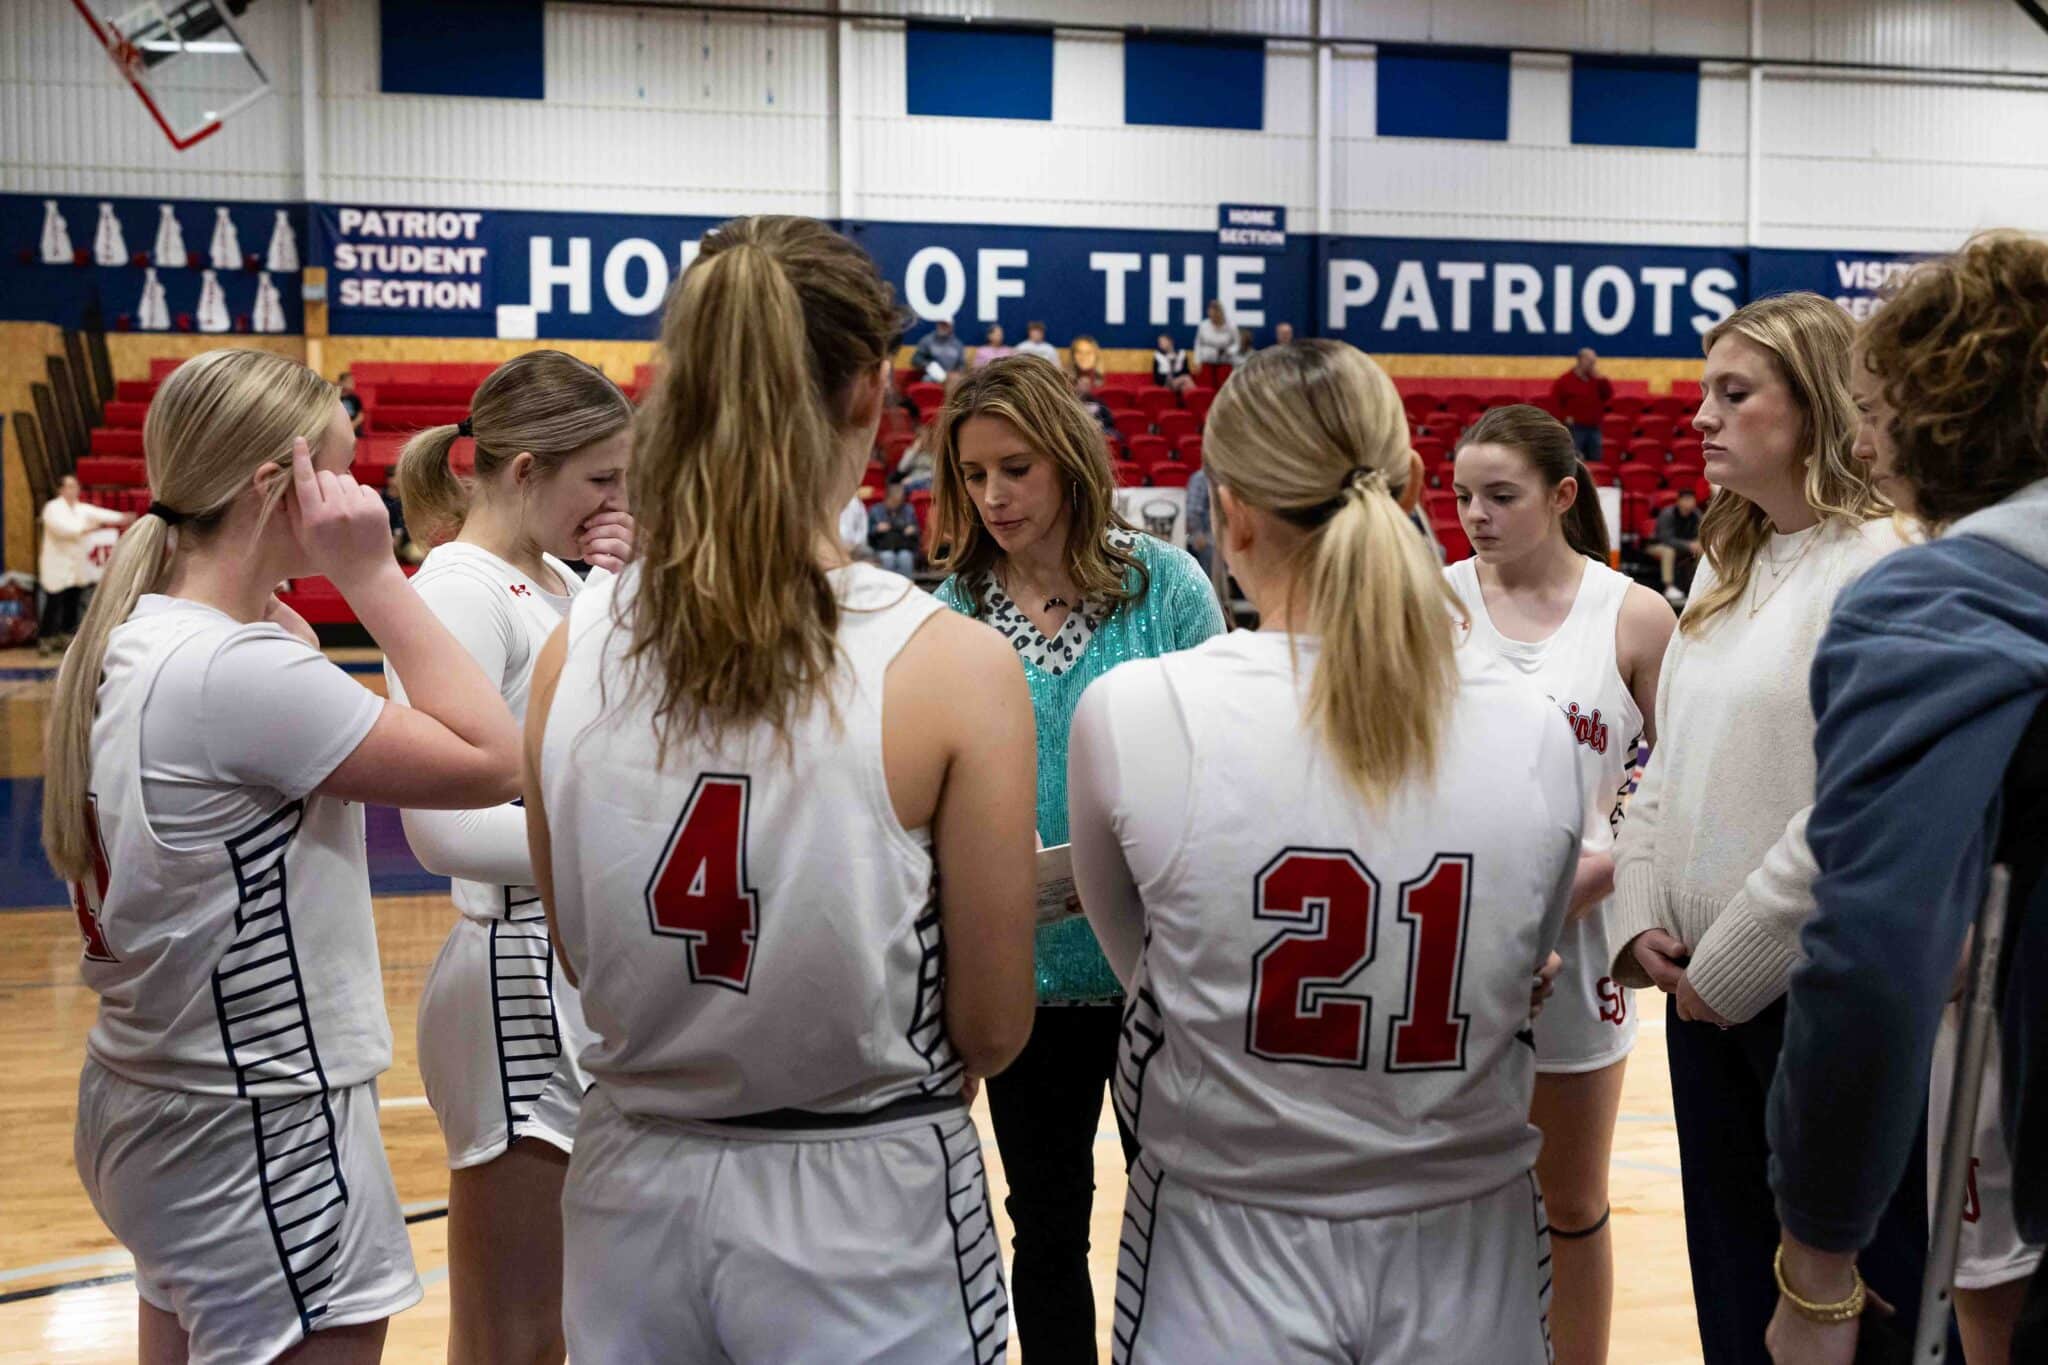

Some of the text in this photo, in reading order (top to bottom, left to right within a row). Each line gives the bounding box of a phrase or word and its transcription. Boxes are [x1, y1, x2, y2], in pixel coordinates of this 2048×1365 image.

[338, 208, 483, 240] PATRIOT
[1220, 228, 1285, 246] SECTION
[333, 243, 488, 275] STUDENT
[339, 277, 482, 310] SECTION
[529, 235, 1739, 337] HO OF THE PATRIOTS
[644, 771, 761, 995] 4
[1245, 845, 1474, 1074] 21
